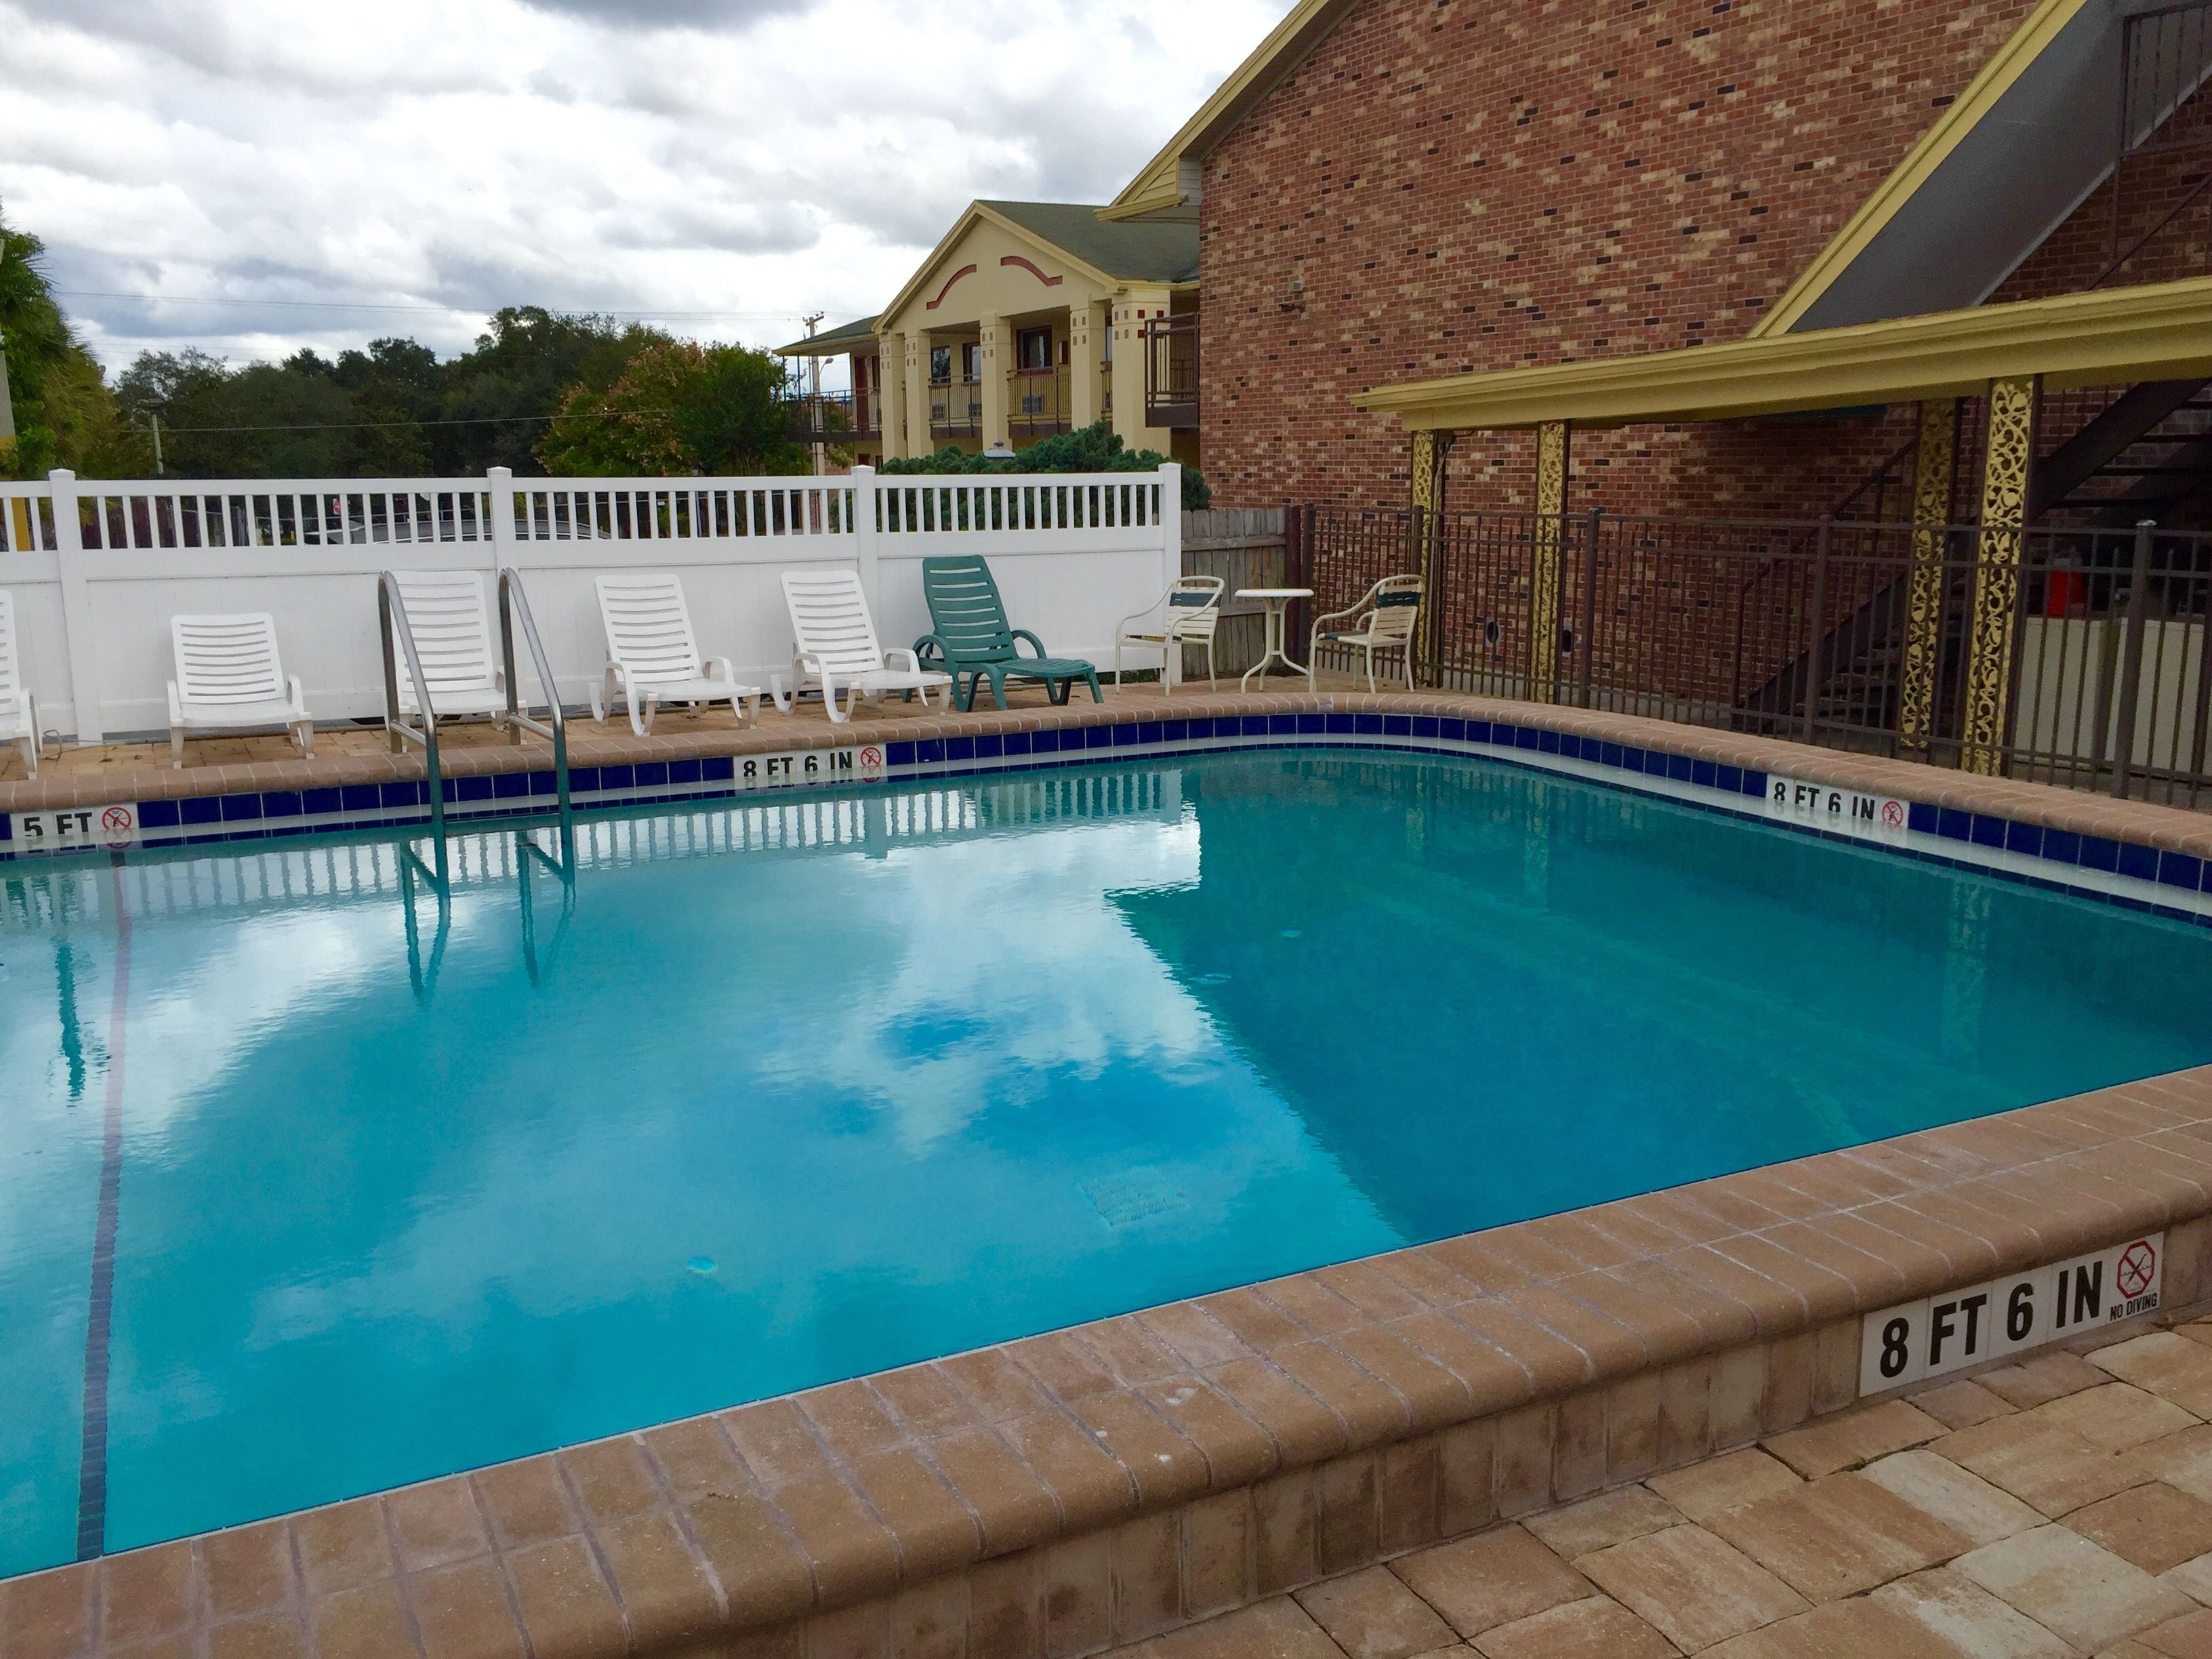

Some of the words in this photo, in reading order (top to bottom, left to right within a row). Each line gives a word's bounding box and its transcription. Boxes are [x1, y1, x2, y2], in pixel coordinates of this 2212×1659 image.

[743, 760, 757, 777] 8
[767, 757, 794, 775] FT
[804, 756, 818, 772] 6
[830, 752, 853, 770] IN
[1774, 782, 1786, 801] 8
[1795, 785, 1820, 808] FT
[1828, 793, 1841, 813] 6
[1852, 796, 1875, 820] IN
[24, 817, 43, 837] 5
[56, 812, 93, 835] FT
[1880, 1317, 1909, 1378] 8
[1930, 1293, 1987, 1366] FT
[2007, 1283, 2034, 1341] 6
[2056, 1261, 2103, 1328] IN
[2110, 1304, 2123, 1322] NO
[2127, 1292, 2158, 1315] DIVING
